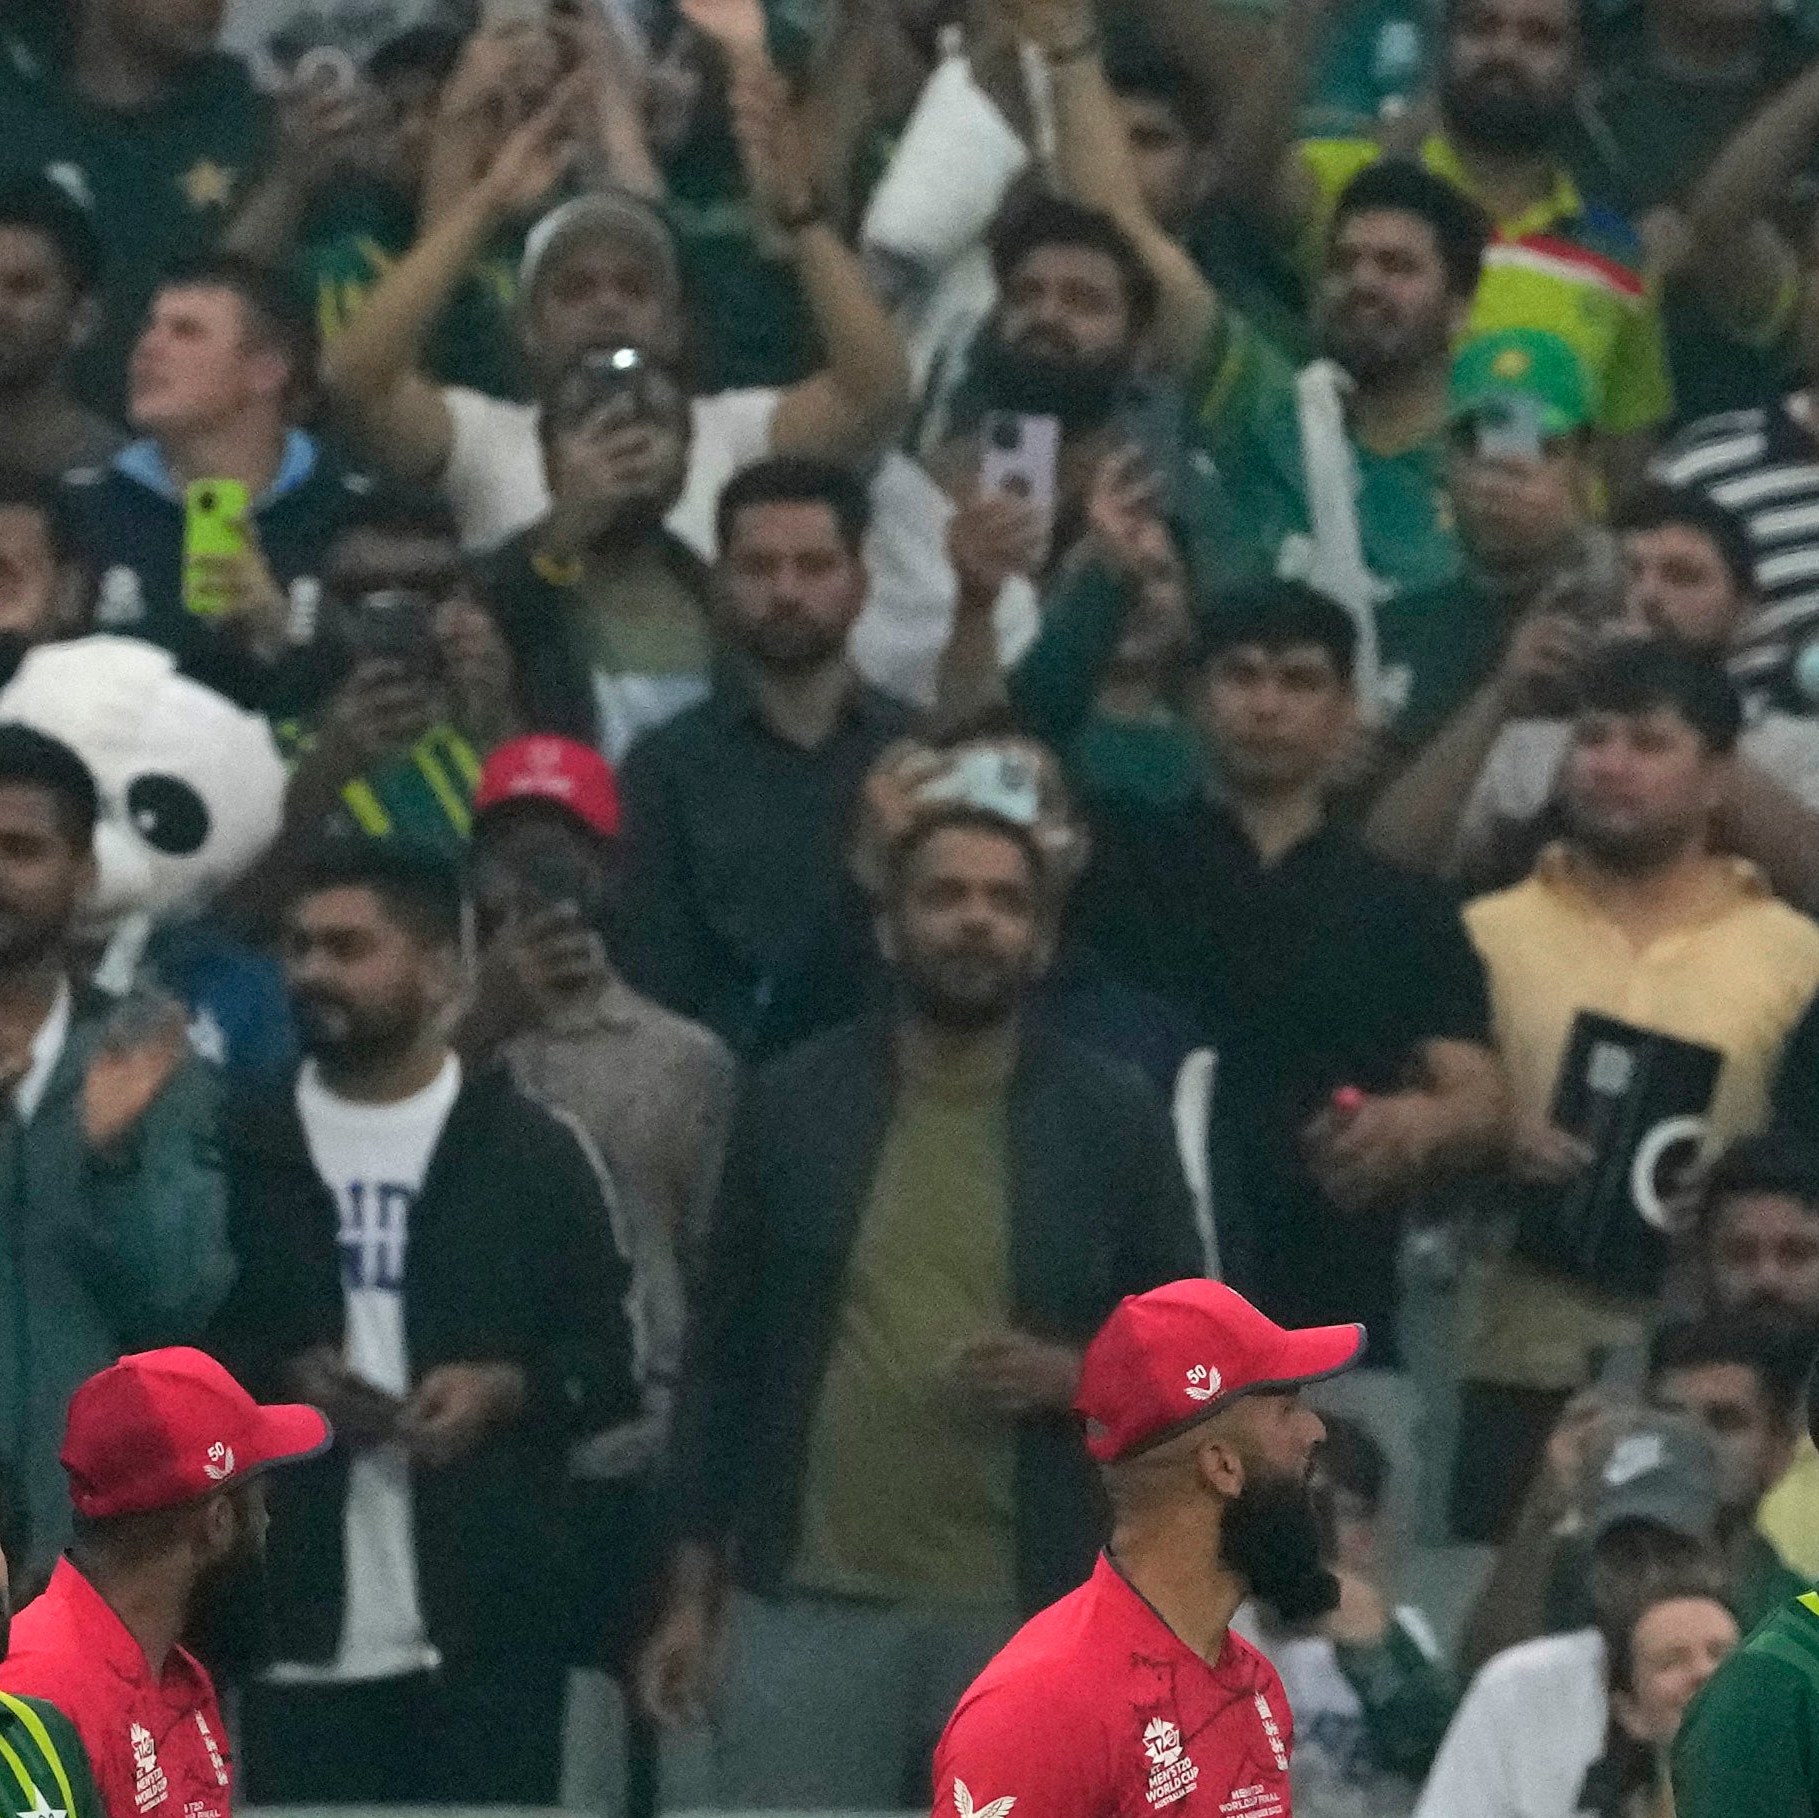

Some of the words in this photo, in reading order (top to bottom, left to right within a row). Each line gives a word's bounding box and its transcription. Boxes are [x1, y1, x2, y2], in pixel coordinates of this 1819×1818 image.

[1186, 1364, 1207, 1384] 50
[207, 1441, 224, 1462] 50
[1145, 1778, 1181, 1803] WORLD
[1181, 1766, 1199, 1784] CUP
[1148, 1766, 1177, 1789] MEN'S
